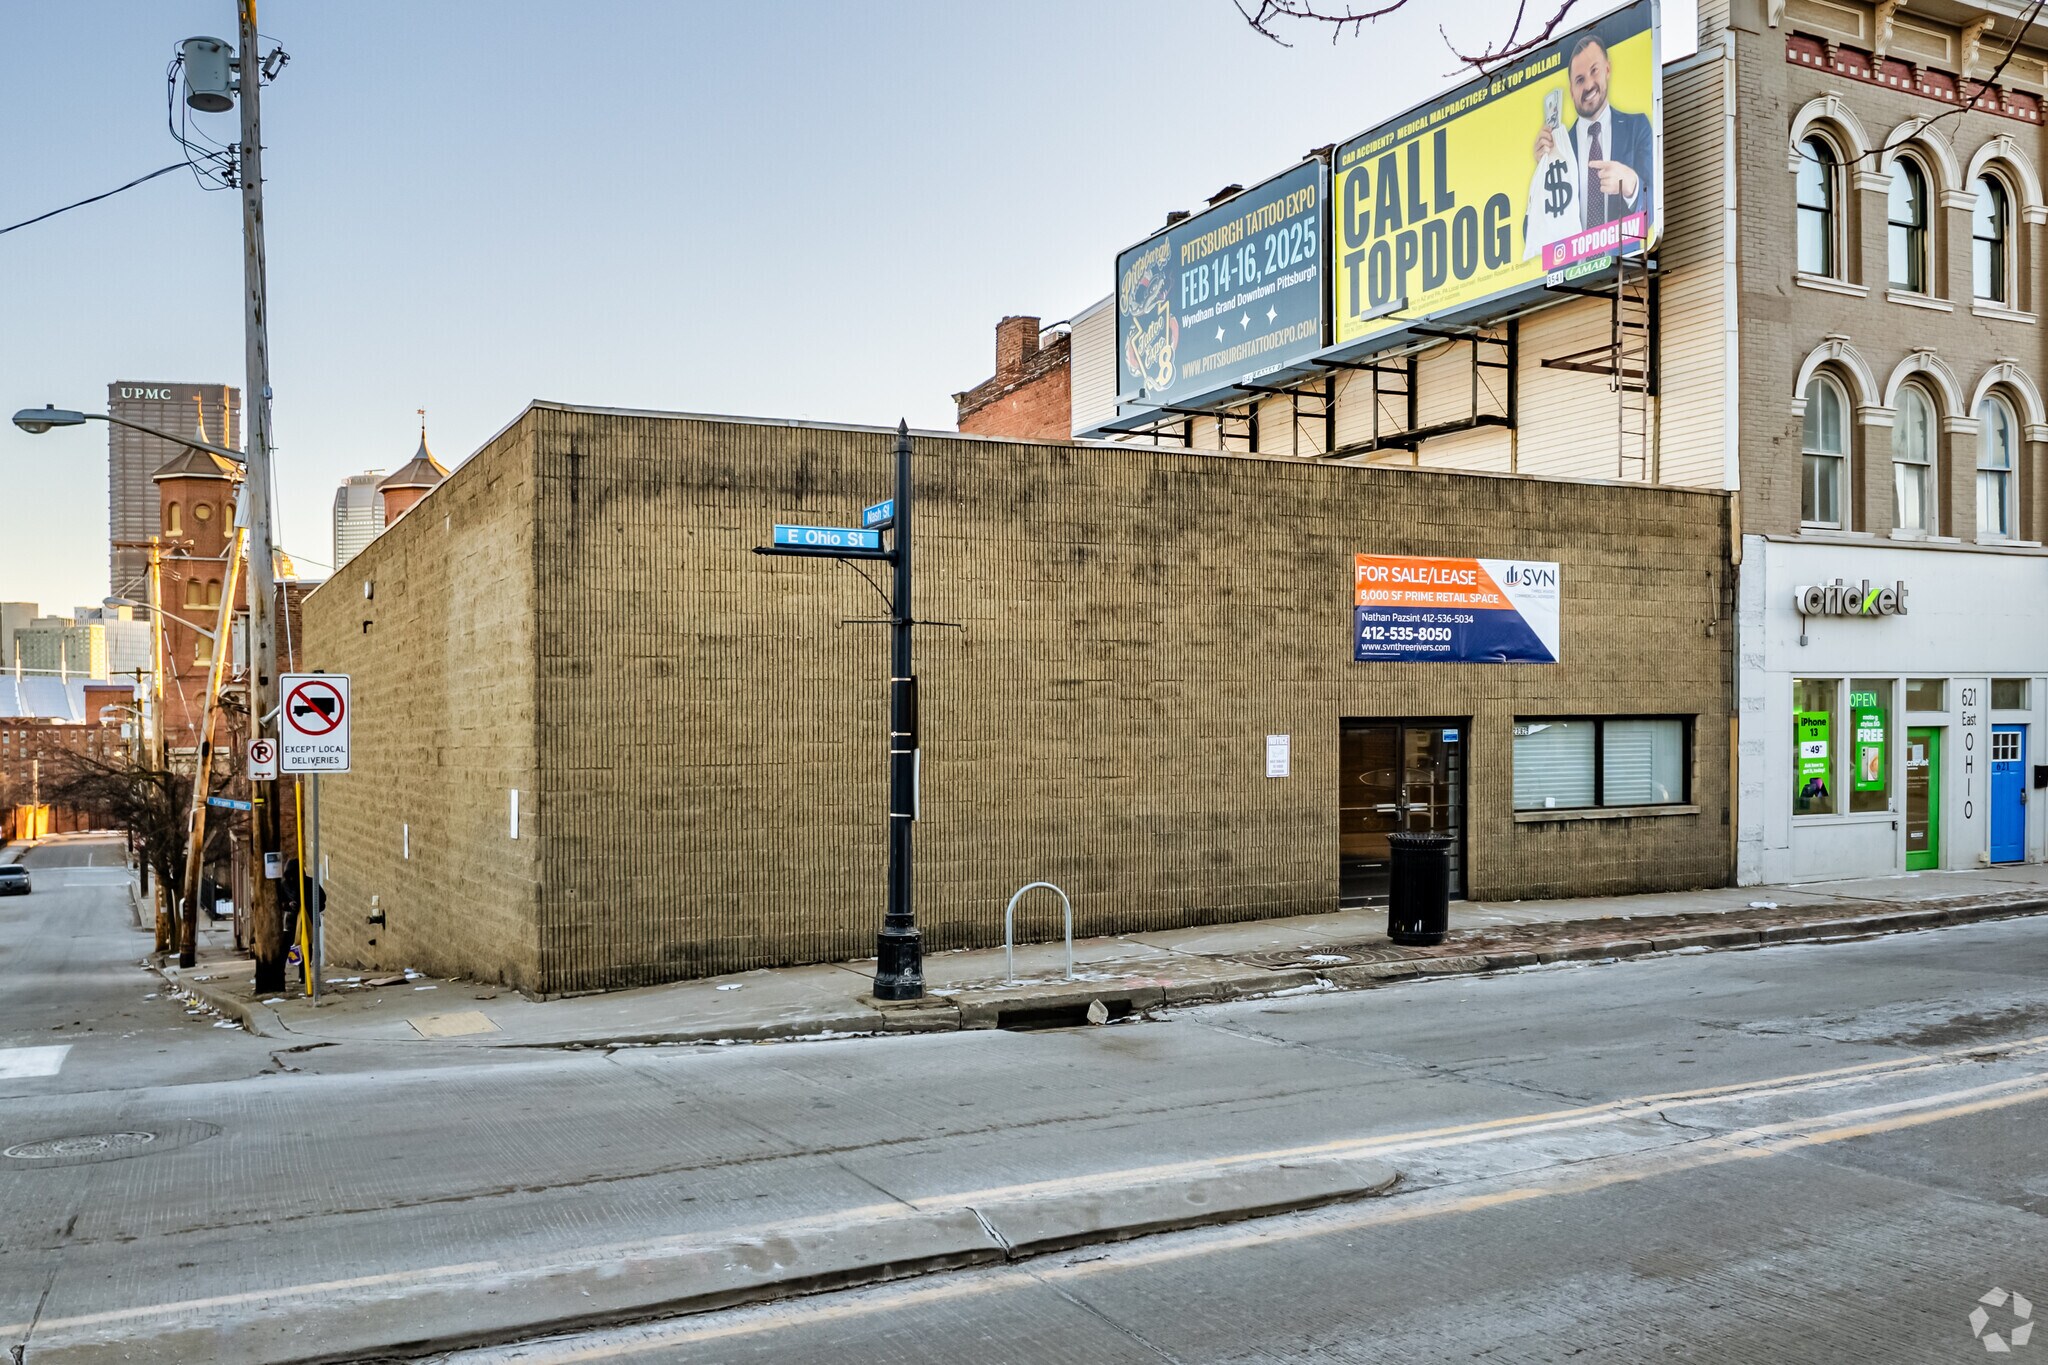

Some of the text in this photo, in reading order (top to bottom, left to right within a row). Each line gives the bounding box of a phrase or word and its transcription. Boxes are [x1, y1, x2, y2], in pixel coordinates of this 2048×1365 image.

[1342, 52, 1561, 166] CAR ACCIDENT? MEDICAL MALPRACTICE? GET TOP DOLLAR!
[1343, 127, 1455, 249] CALL
[1181, 184, 1315, 267] PITTSBURGH TATTOO EXPO
[1181, 215, 1317, 309] FEB 14-16, 2025
[1344, 192, 1511, 319] TOPDOG
[1120, 236, 1171, 317] Pittsburgh
[1569, 258, 1608, 278] LAMAR
[1182, 263, 1317, 328] Wyndham Grand Downtown Pittsburgh
[1182, 317, 1317, 380] WWW.PITTSBURGHTATTOOEXPO.COM
[1158, 345, 1173, 386] 8
[120, 387, 172, 400] UPMC
[787, 529, 864, 547] E Ohio St
[1358, 566, 1477, 586] FOR SALE/LEASE
[1522, 568, 1555, 587] SVN
[1391, 591, 1403, 601] SF
[1405, 592, 1434, 602] PRIME
[1436, 592, 1468, 603] RETAIL
[1469, 593, 1499, 604] SPACE
[1802, 578, 1908, 616] cricket
[1361, 612, 1474, 624] Nathan Pazsint 412-536-5034
[1361, 626, 1452, 641] 412-535-8050
[1361, 642, 1451, 652] www.svnthreerivers.com
[1850, 693, 1877, 707] OPEN
[1962, 688, 1977, 707] 621
[1800, 717, 1827, 727] iPhone
[1962, 711, 1977, 726] East
[1810, 728, 1818, 737] 13
[1857, 728, 1884, 742] FREE
[285, 745, 346, 753] EXCEPT LOCAL
[291, 756, 340, 764] DELIVERIES
[1996, 762, 2009, 771] 621
